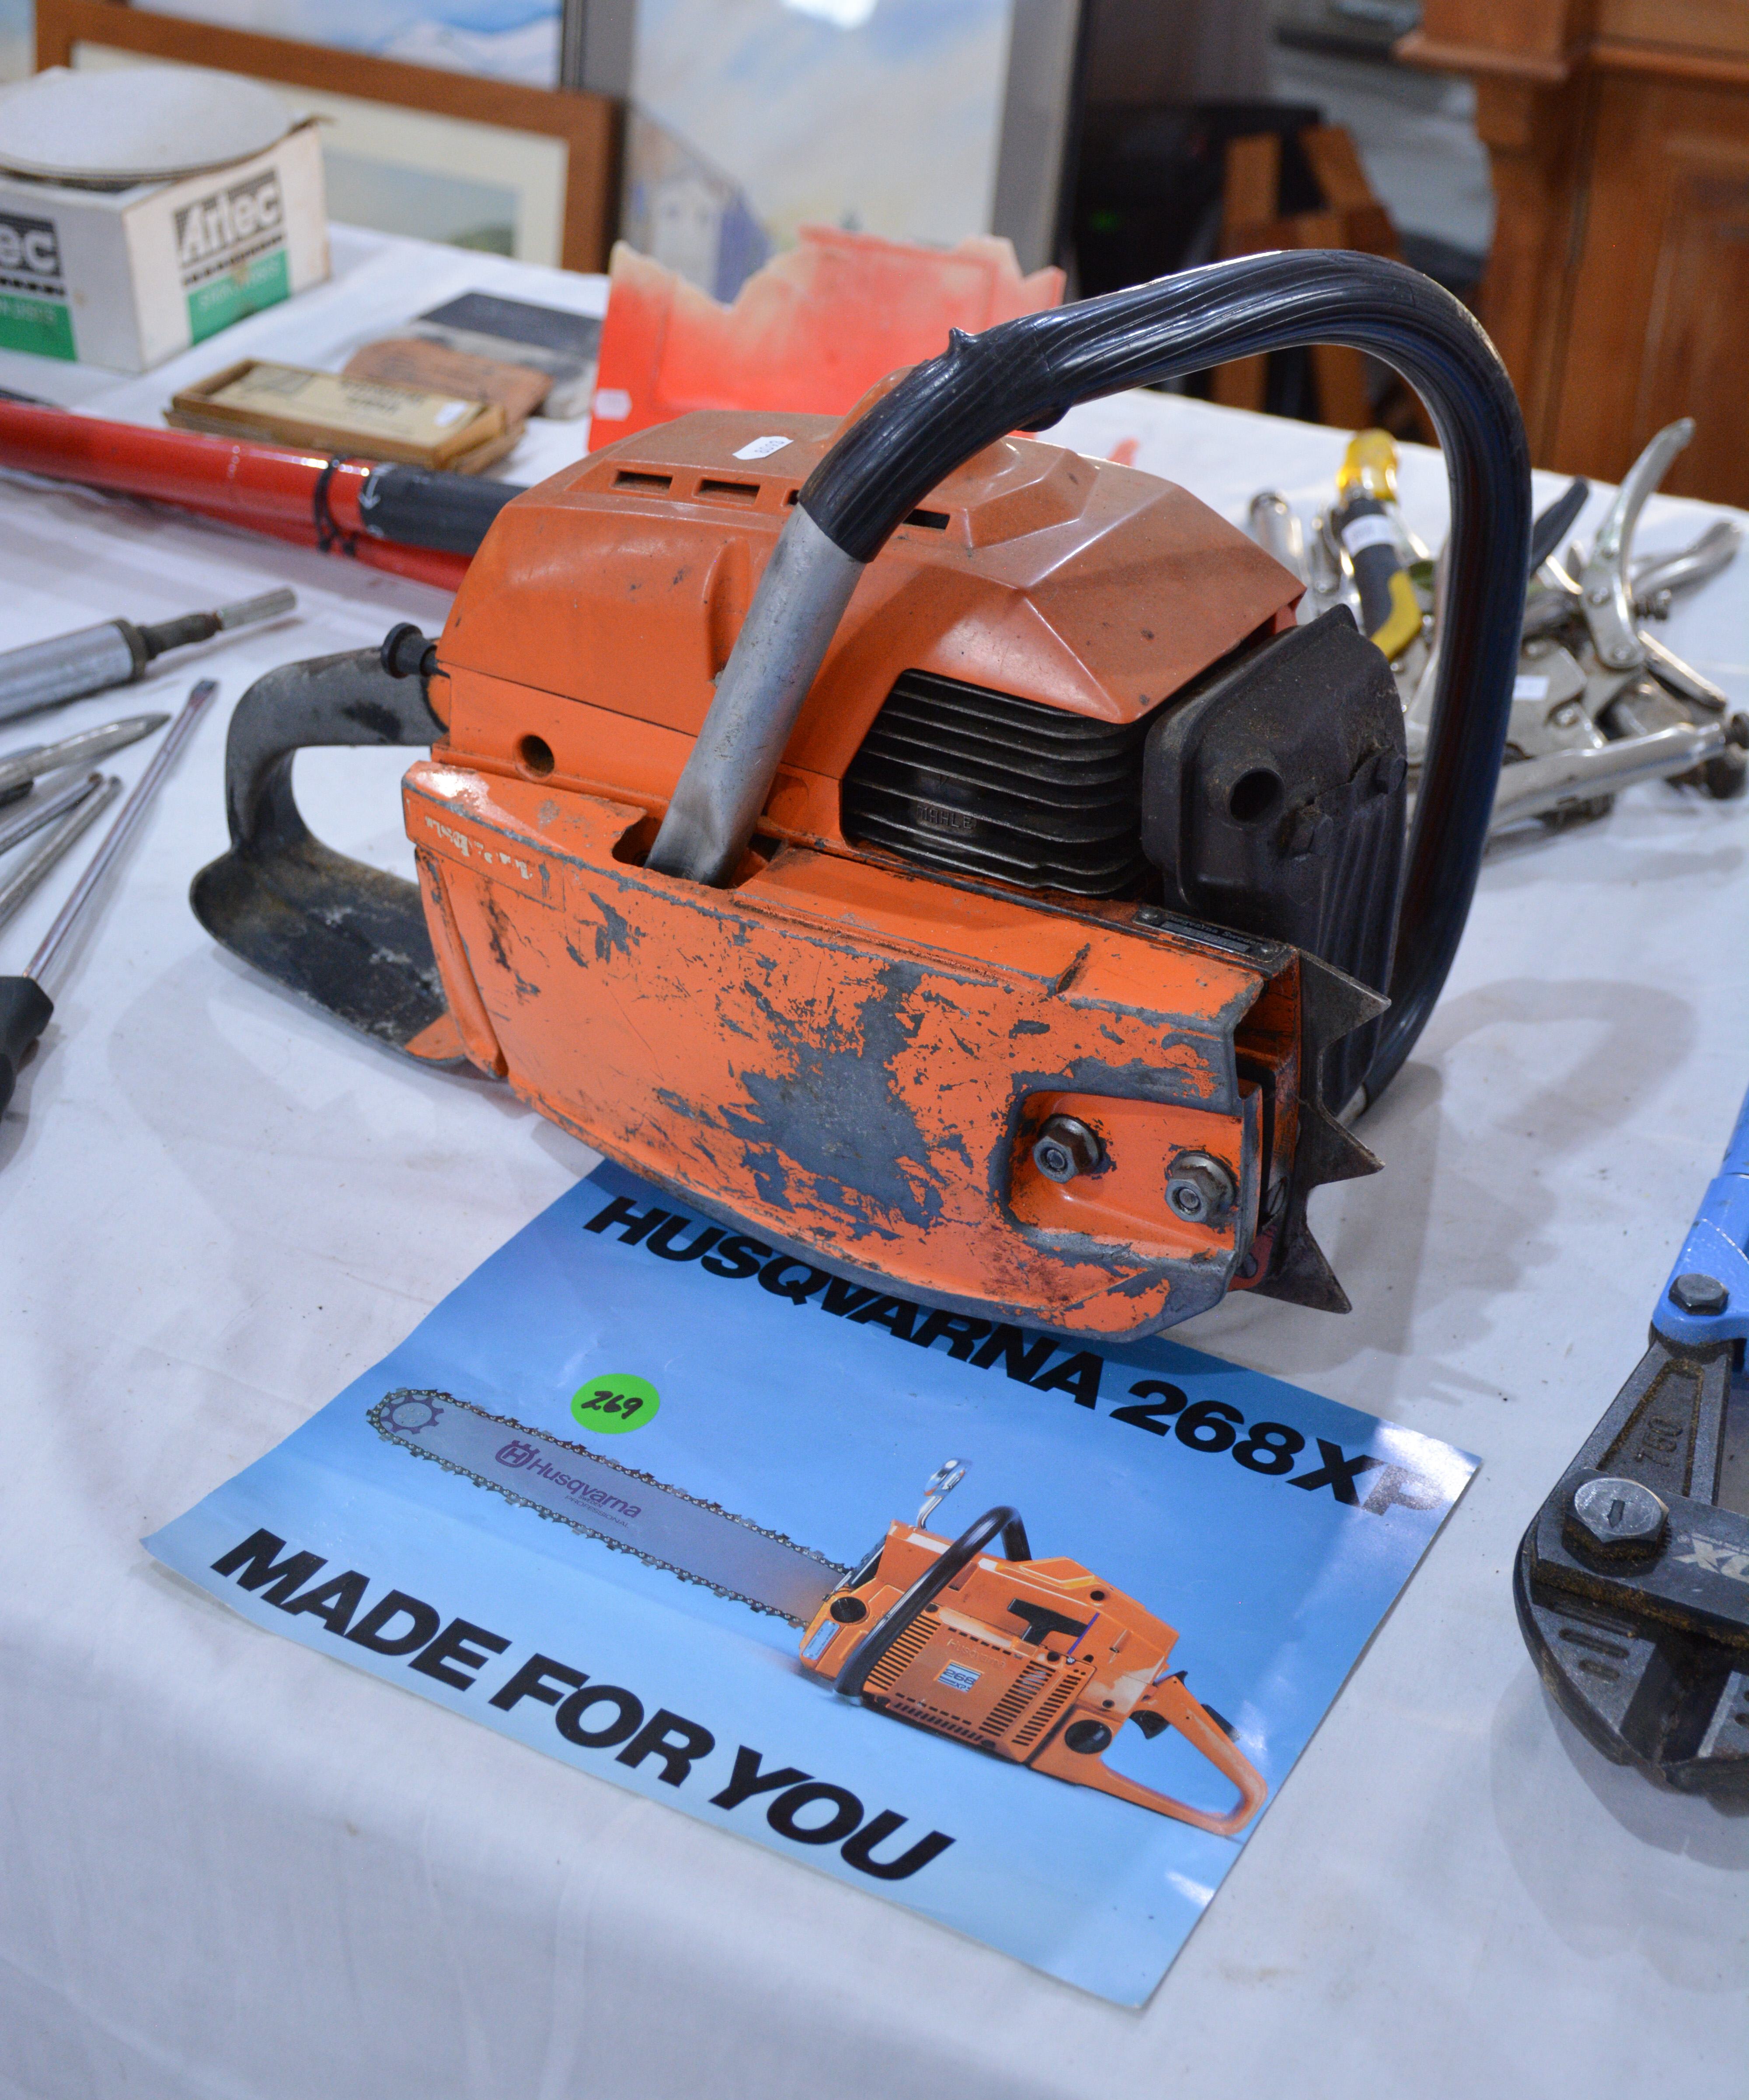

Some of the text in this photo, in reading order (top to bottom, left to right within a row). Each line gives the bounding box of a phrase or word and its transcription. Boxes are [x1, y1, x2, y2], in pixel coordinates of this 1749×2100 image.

[583, 1196, 1446, 1516] HUSQVARNA 268XP
[581, 1391, 643, 1419] 269
[527, 1458, 642, 1518] Husqvarna
[565, 1495, 629, 1529] PROFESSIONAL
[942, 1669, 977, 1685] 268
[210, 1528, 956, 1880] MADE FOR YOU
